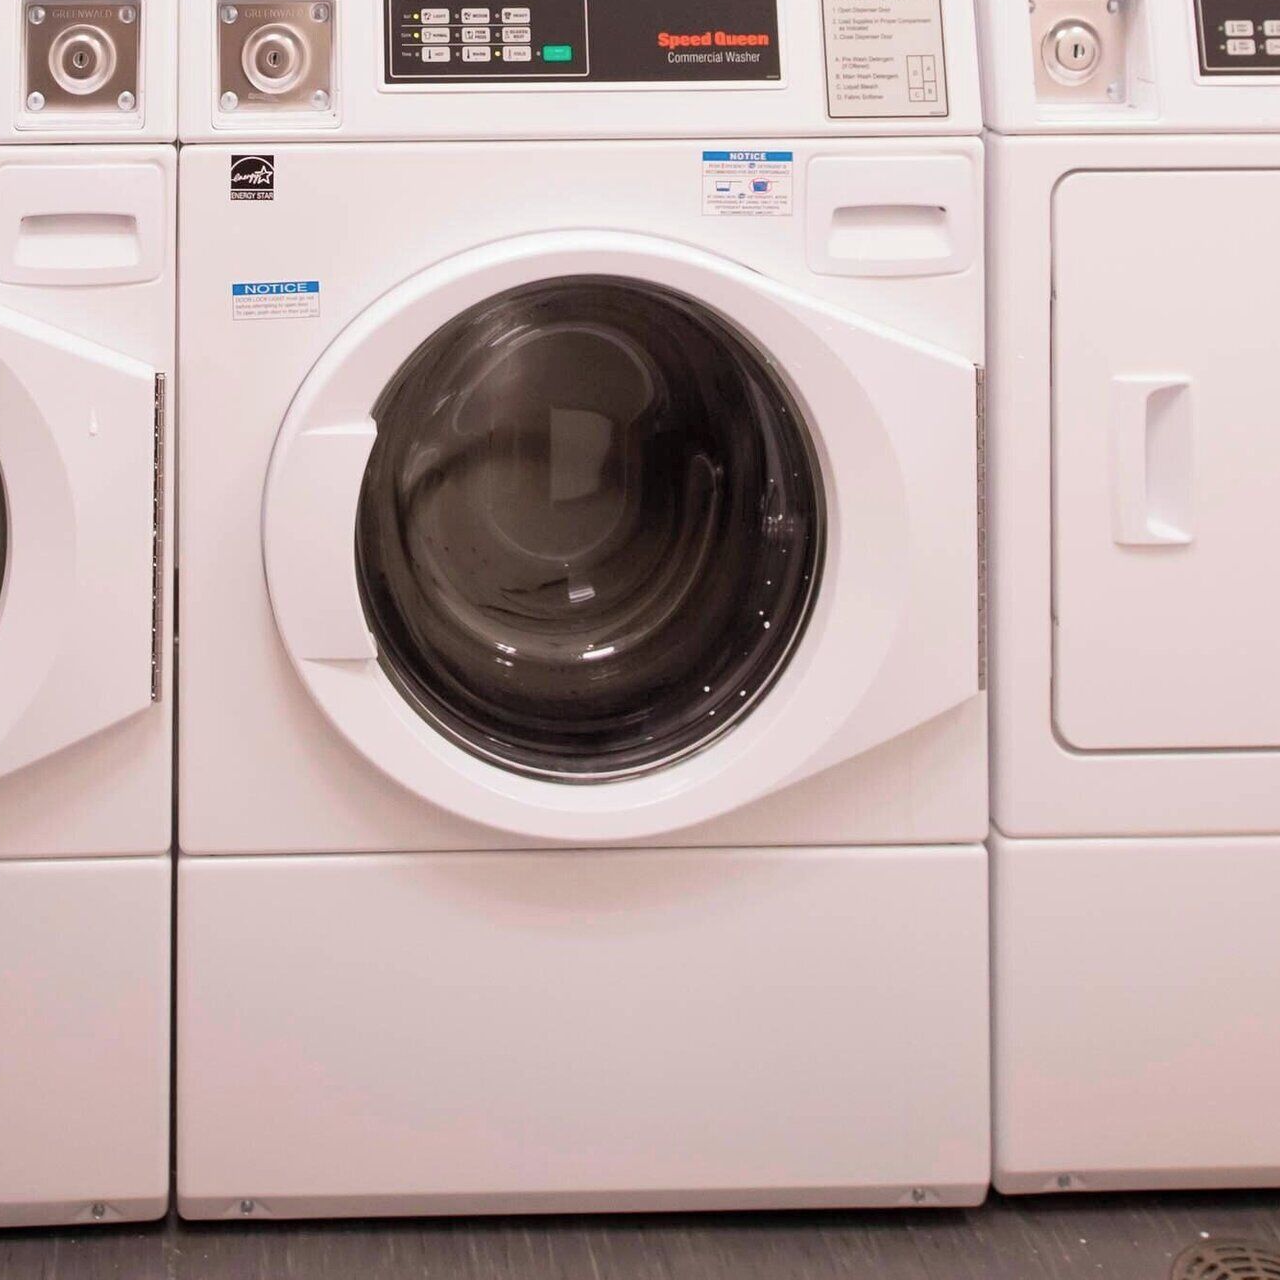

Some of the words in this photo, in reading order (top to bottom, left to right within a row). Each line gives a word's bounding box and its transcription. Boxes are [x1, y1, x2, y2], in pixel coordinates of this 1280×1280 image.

[52, 8, 112, 19] GREENWALD
[658, 32, 712, 49] Speed
[714, 31, 769, 46] Queen
[667, 52, 723, 63] Commercial
[725, 52, 761, 63] Washer
[729, 152, 767, 160] NOTICE
[231, 192, 256, 200] ENERGY
[256, 192, 274, 200] STAR
[244, 283, 308, 294] NOTICE
